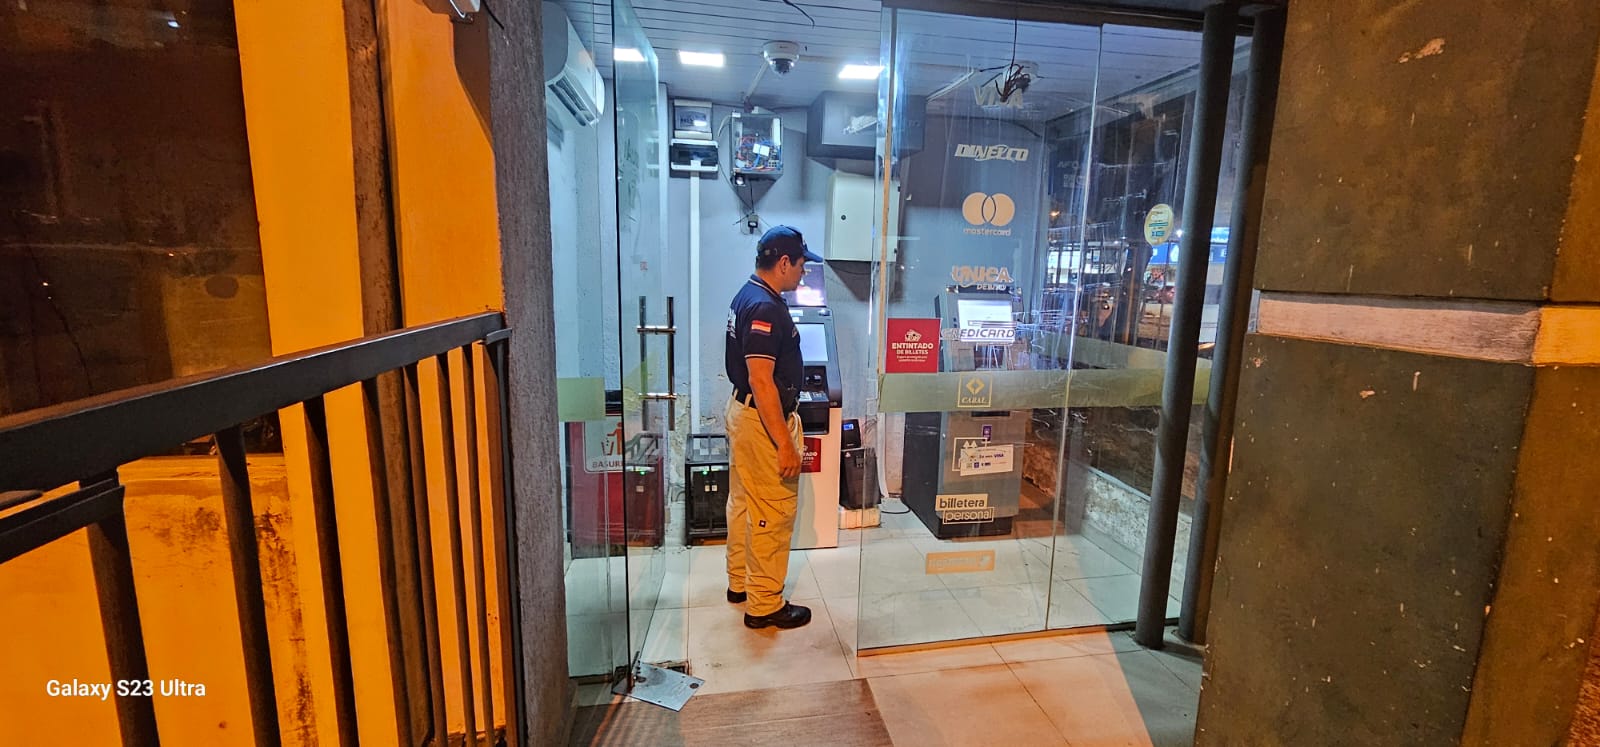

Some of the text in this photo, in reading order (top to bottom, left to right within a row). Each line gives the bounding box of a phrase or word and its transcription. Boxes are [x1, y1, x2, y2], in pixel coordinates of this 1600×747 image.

[973, 85, 1024, 109] VIA
[963, 227, 1012, 237] mastercard
[941, 327, 1015, 340] CREDICARD
[891, 342, 934, 350] ENTINTADO
[961, 396, 987, 404] CABAL
[592, 460, 624, 468] BASUR
[939, 498, 985, 509] billetera
[945, 507, 992, 523] personal
